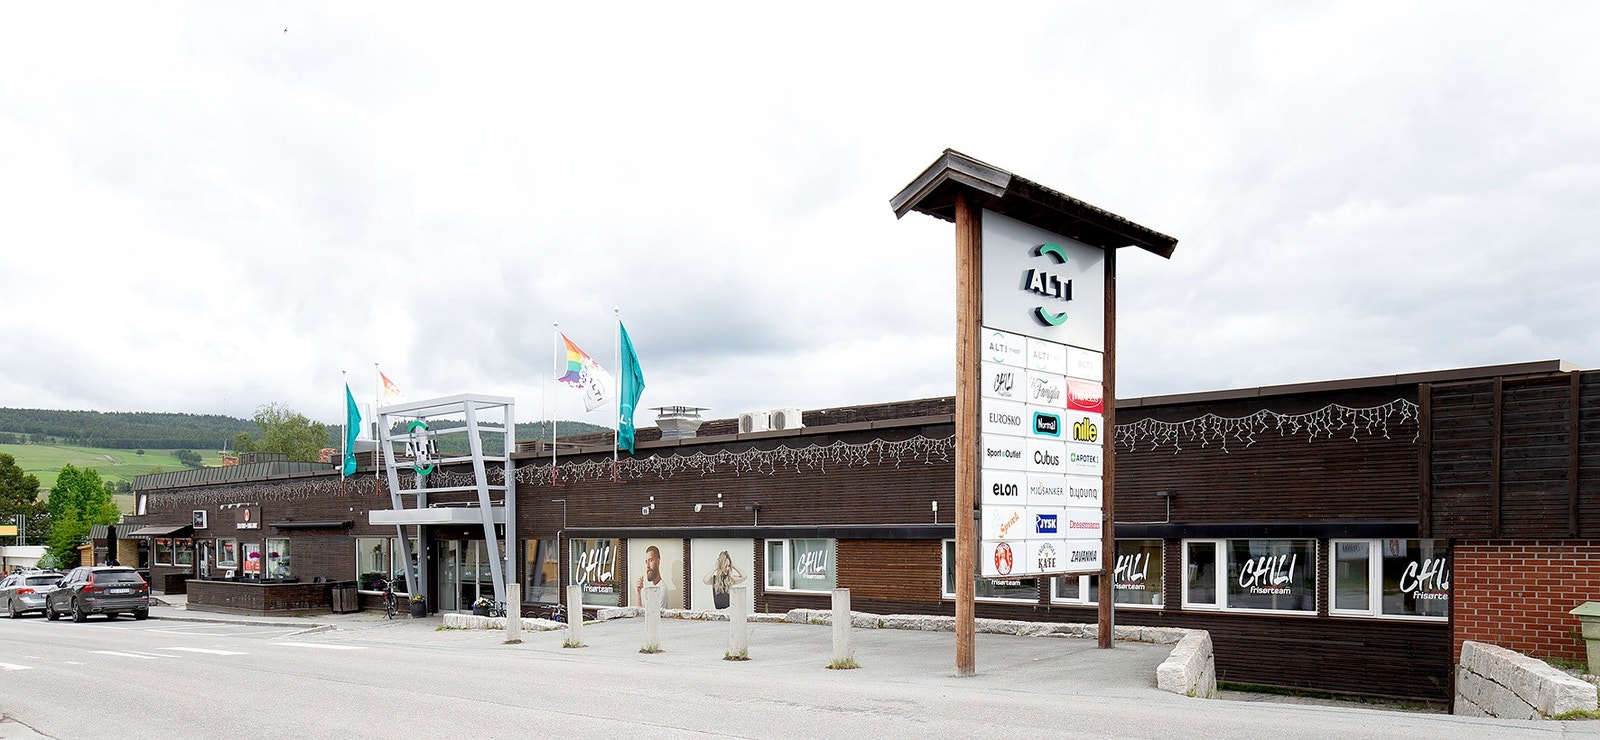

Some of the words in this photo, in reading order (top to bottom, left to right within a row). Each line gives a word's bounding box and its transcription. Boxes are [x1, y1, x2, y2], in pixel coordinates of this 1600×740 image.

[1025, 268, 1073, 301] ALTI
[989, 342, 1008, 353] ALTI
[989, 412, 1021, 426] EUROSKO
[1037, 417, 1056, 430] Normal
[1073, 416, 1097, 442] nille
[1034, 450, 1060, 466] Cubus
[1076, 454, 1096, 463] APOTEK
[993, 483, 1018, 496] elon
[1069, 485, 1098, 500] b.young
[1040, 518, 1057, 529] JYSK
[797, 549, 829, 575] CHILI
[1071, 550, 1097, 563] ZAVANNA
[576, 545, 617, 585] CHILI
[1114, 552, 1150, 582] HILI
[1239, 553, 1297, 588] CHILI
[1114, 582, 1146, 590] risørteam
[1250, 586, 1291, 595] frisørteam
